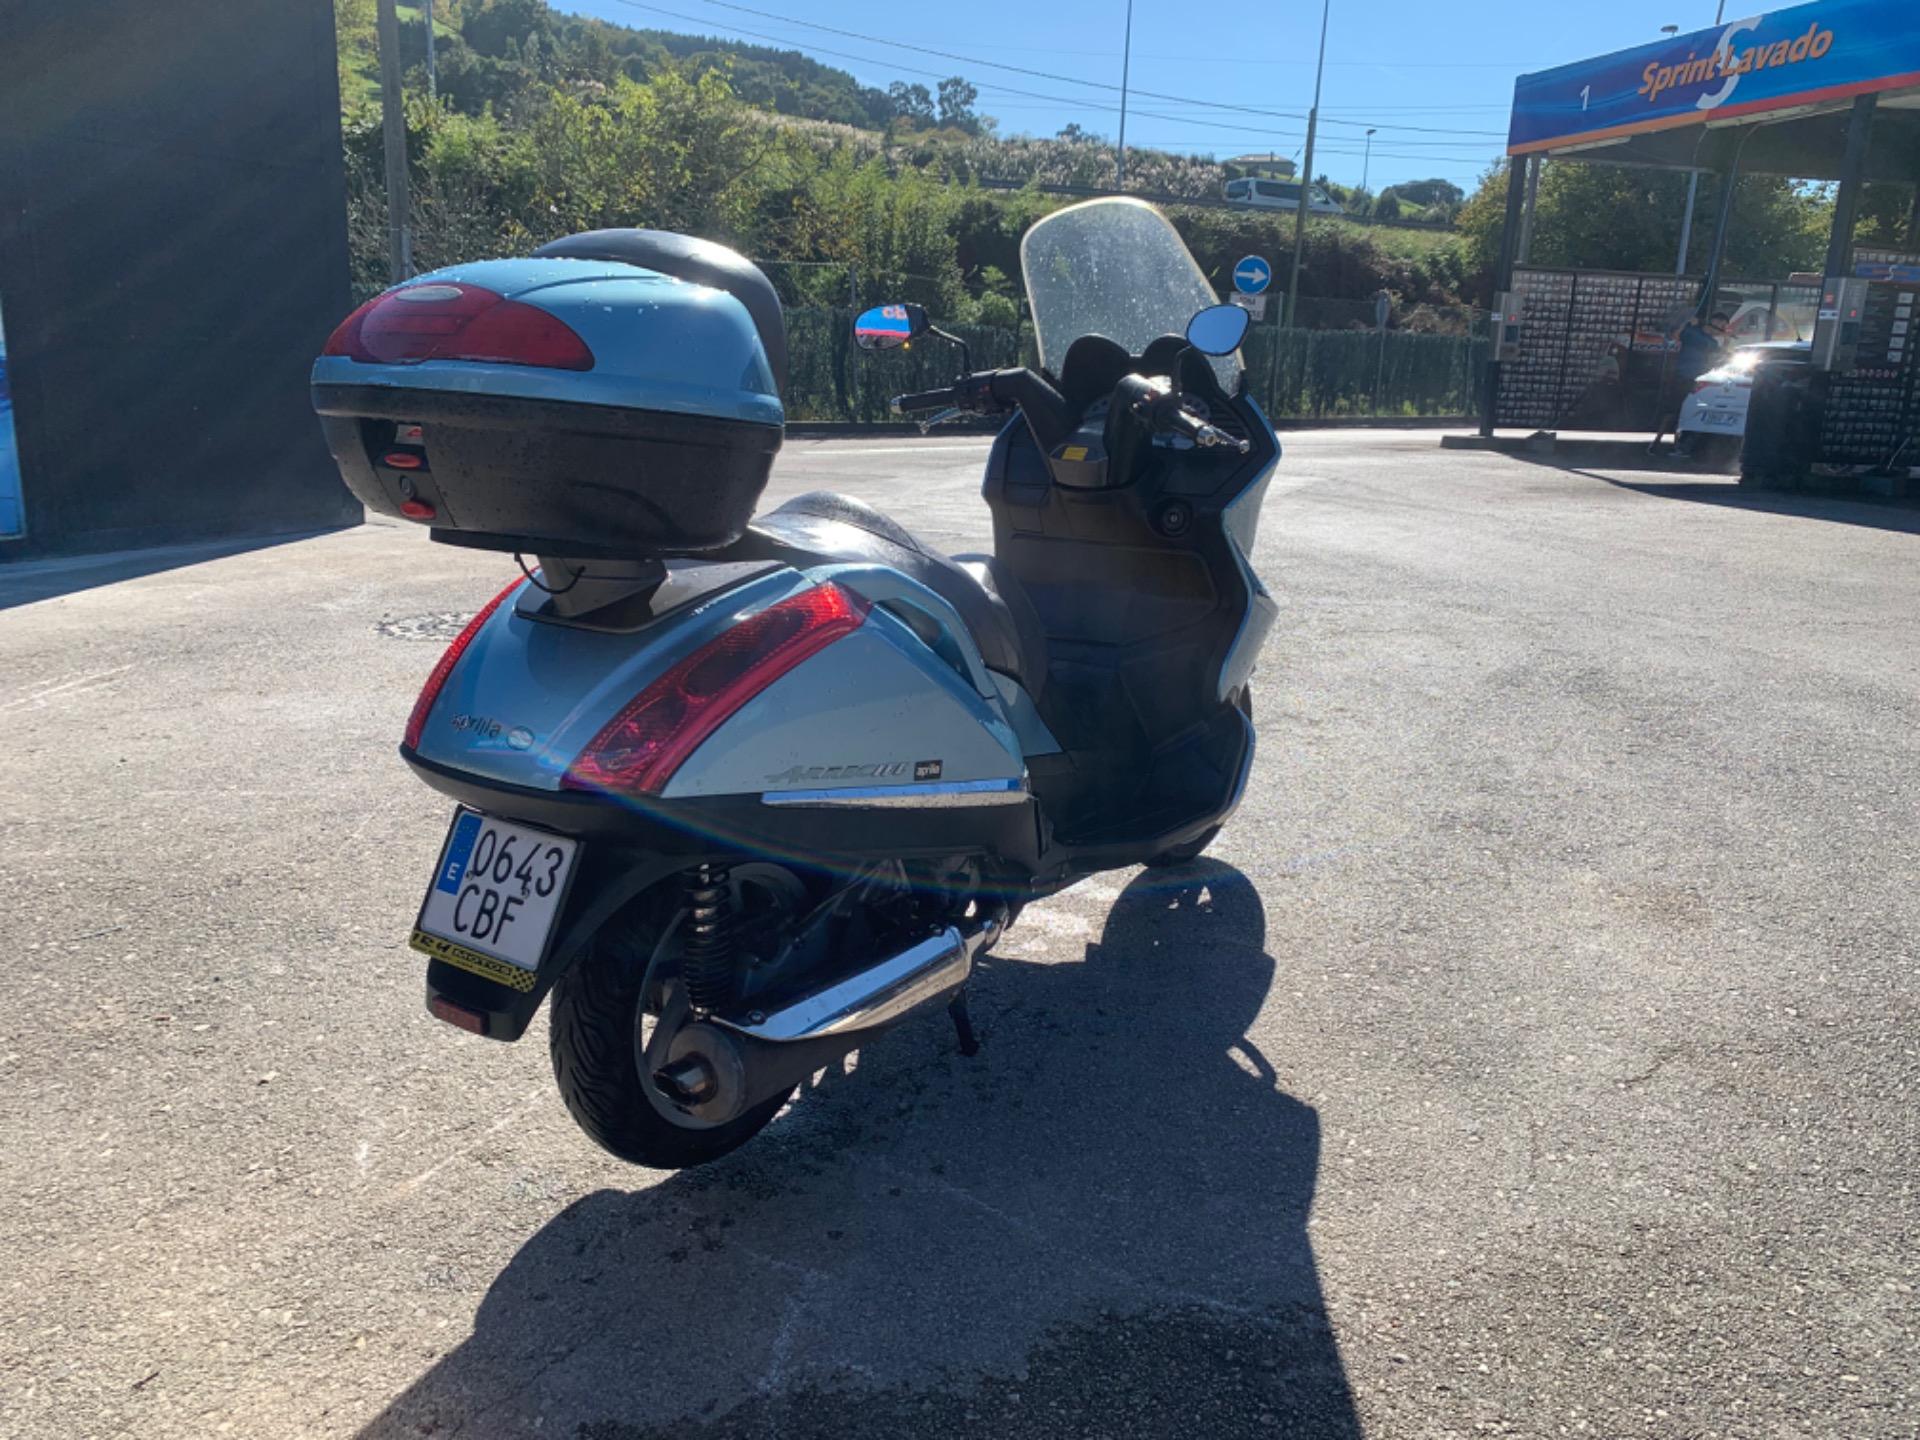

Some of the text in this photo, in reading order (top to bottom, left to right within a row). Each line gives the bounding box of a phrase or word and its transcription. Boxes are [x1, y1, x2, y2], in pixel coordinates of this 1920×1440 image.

[1580, 84, 1591, 111] 1
[446, 862, 461, 880] E
[473, 829, 564, 897] 0643
[454, 884, 524, 944] CBF
